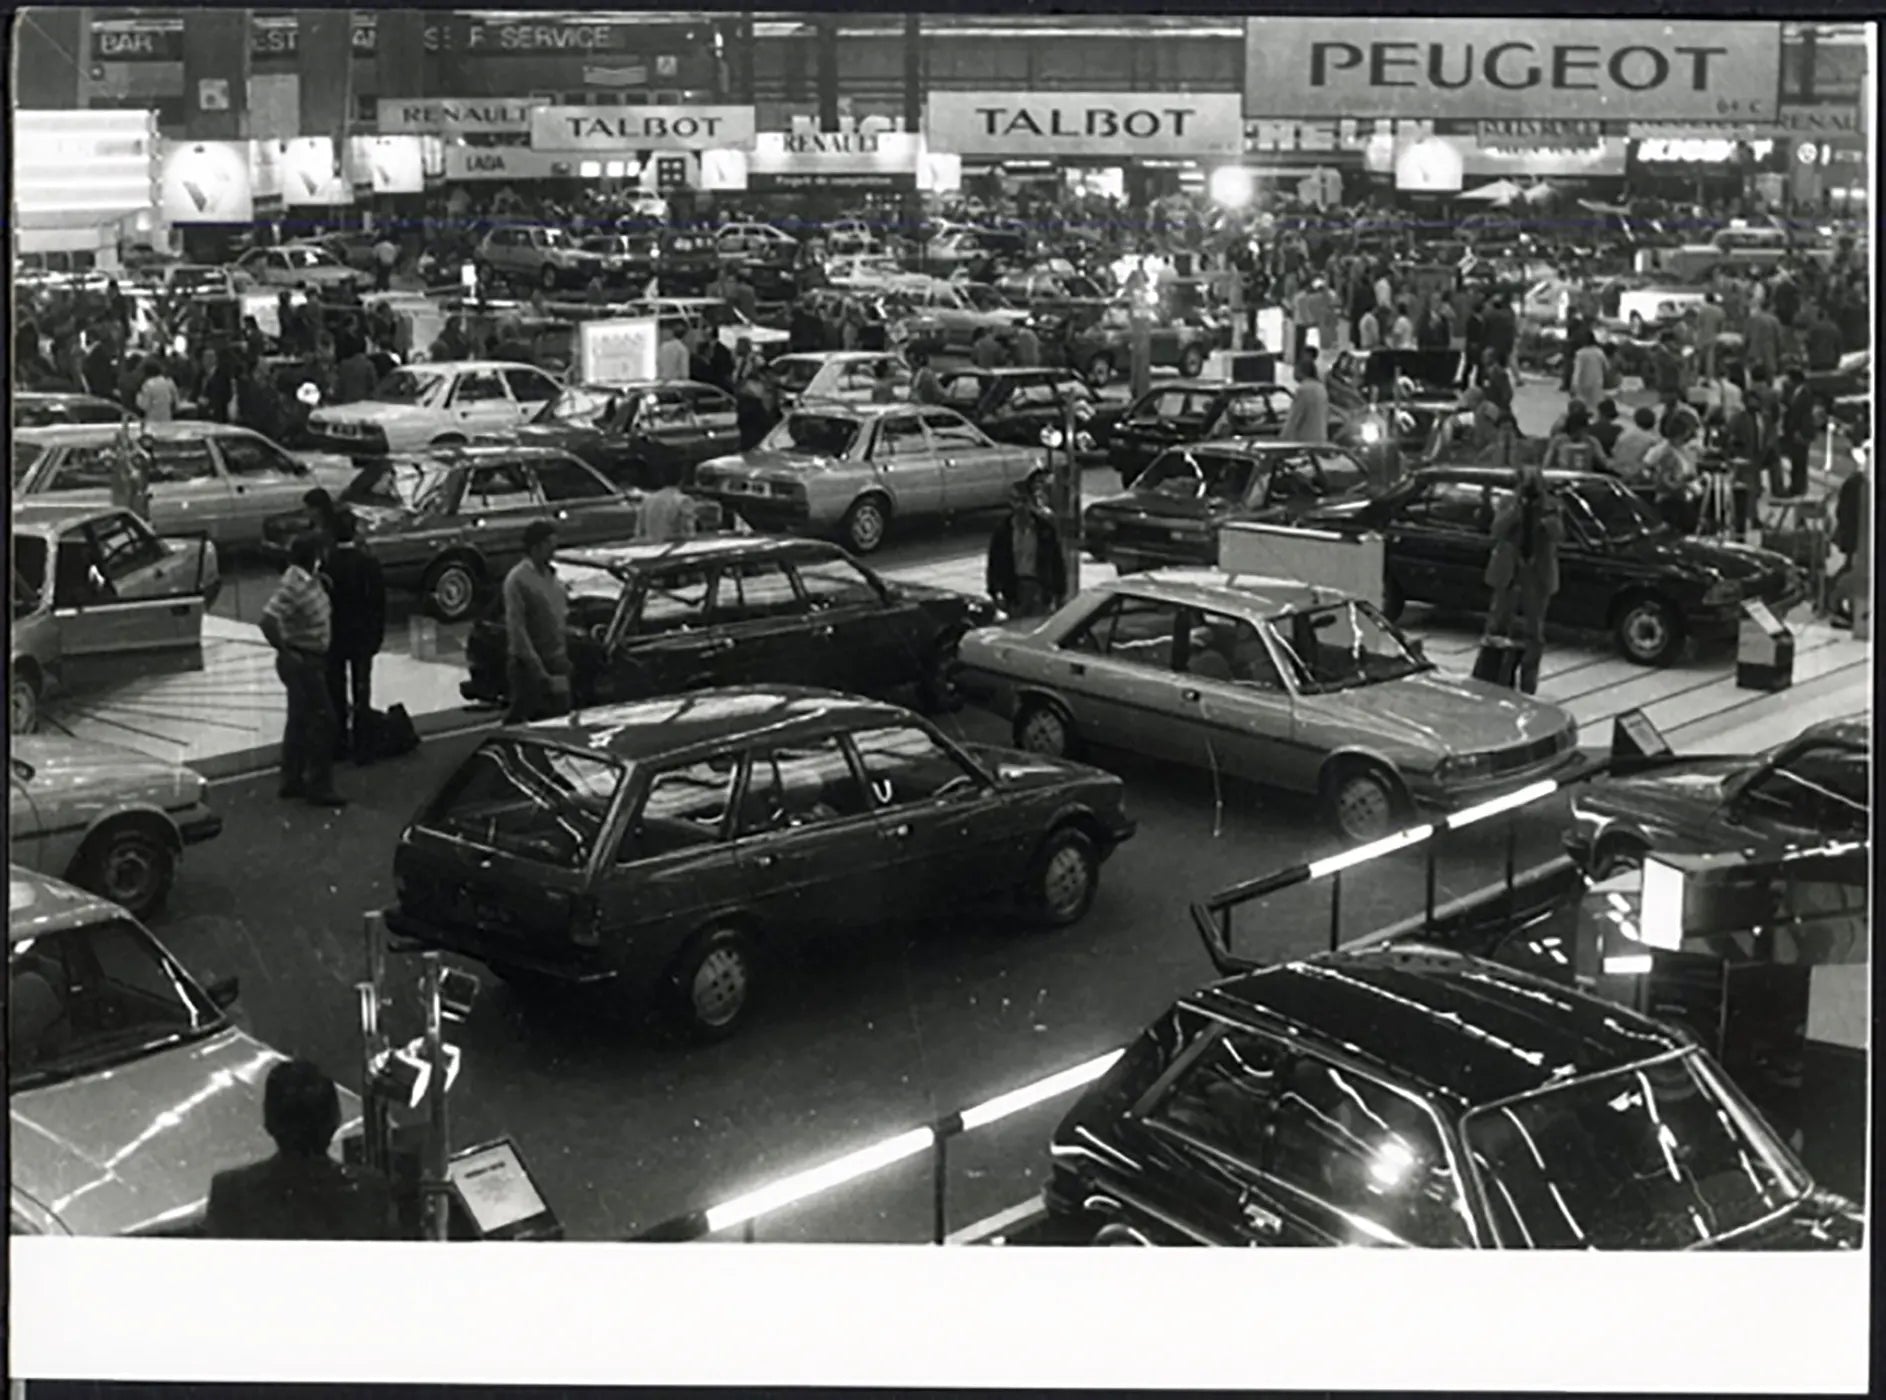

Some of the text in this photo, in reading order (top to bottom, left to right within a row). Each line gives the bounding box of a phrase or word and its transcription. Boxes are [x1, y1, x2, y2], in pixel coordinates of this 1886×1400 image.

[102, 33, 152, 53] BAR
[501, 26, 611, 49] SERVICE
[1308, 41, 1727, 92] PEUGEOT
[403, 106, 527, 122] RENAULT
[566, 116, 723, 138] TALBOT
[975, 108, 1196, 138] TALBOT
